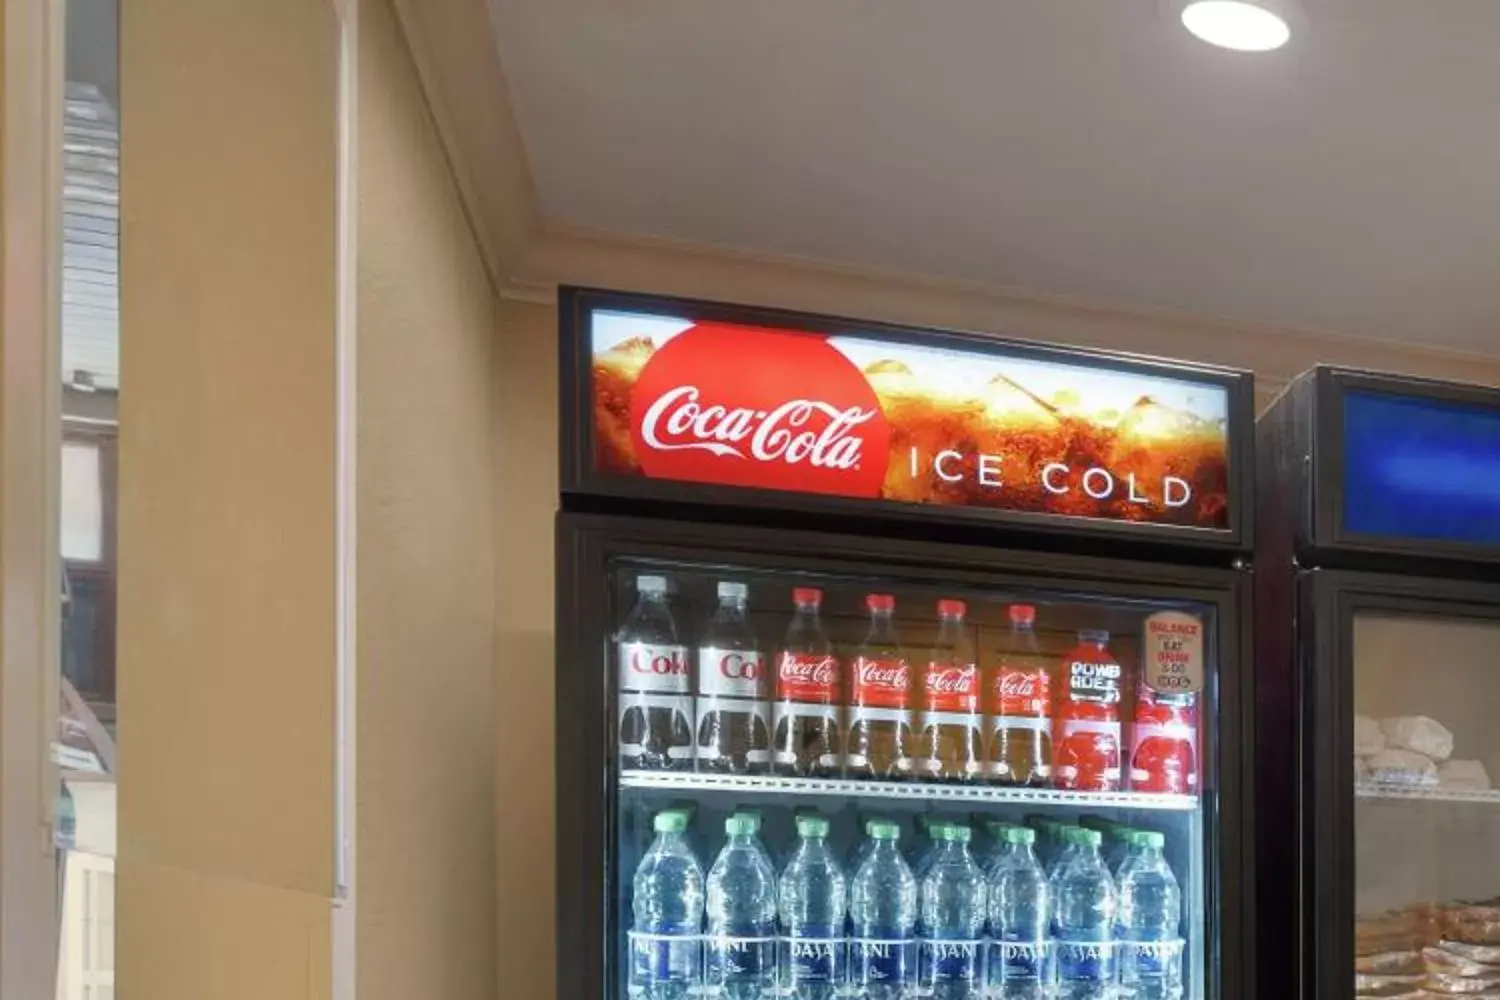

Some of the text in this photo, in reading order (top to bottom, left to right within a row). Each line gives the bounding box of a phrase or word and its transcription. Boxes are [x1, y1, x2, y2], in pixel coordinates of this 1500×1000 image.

[642, 384, 878, 471] Coca-Cola
[909, 446, 1192, 507] ICE COLD
[1149, 621, 1198, 634] BALANCE
